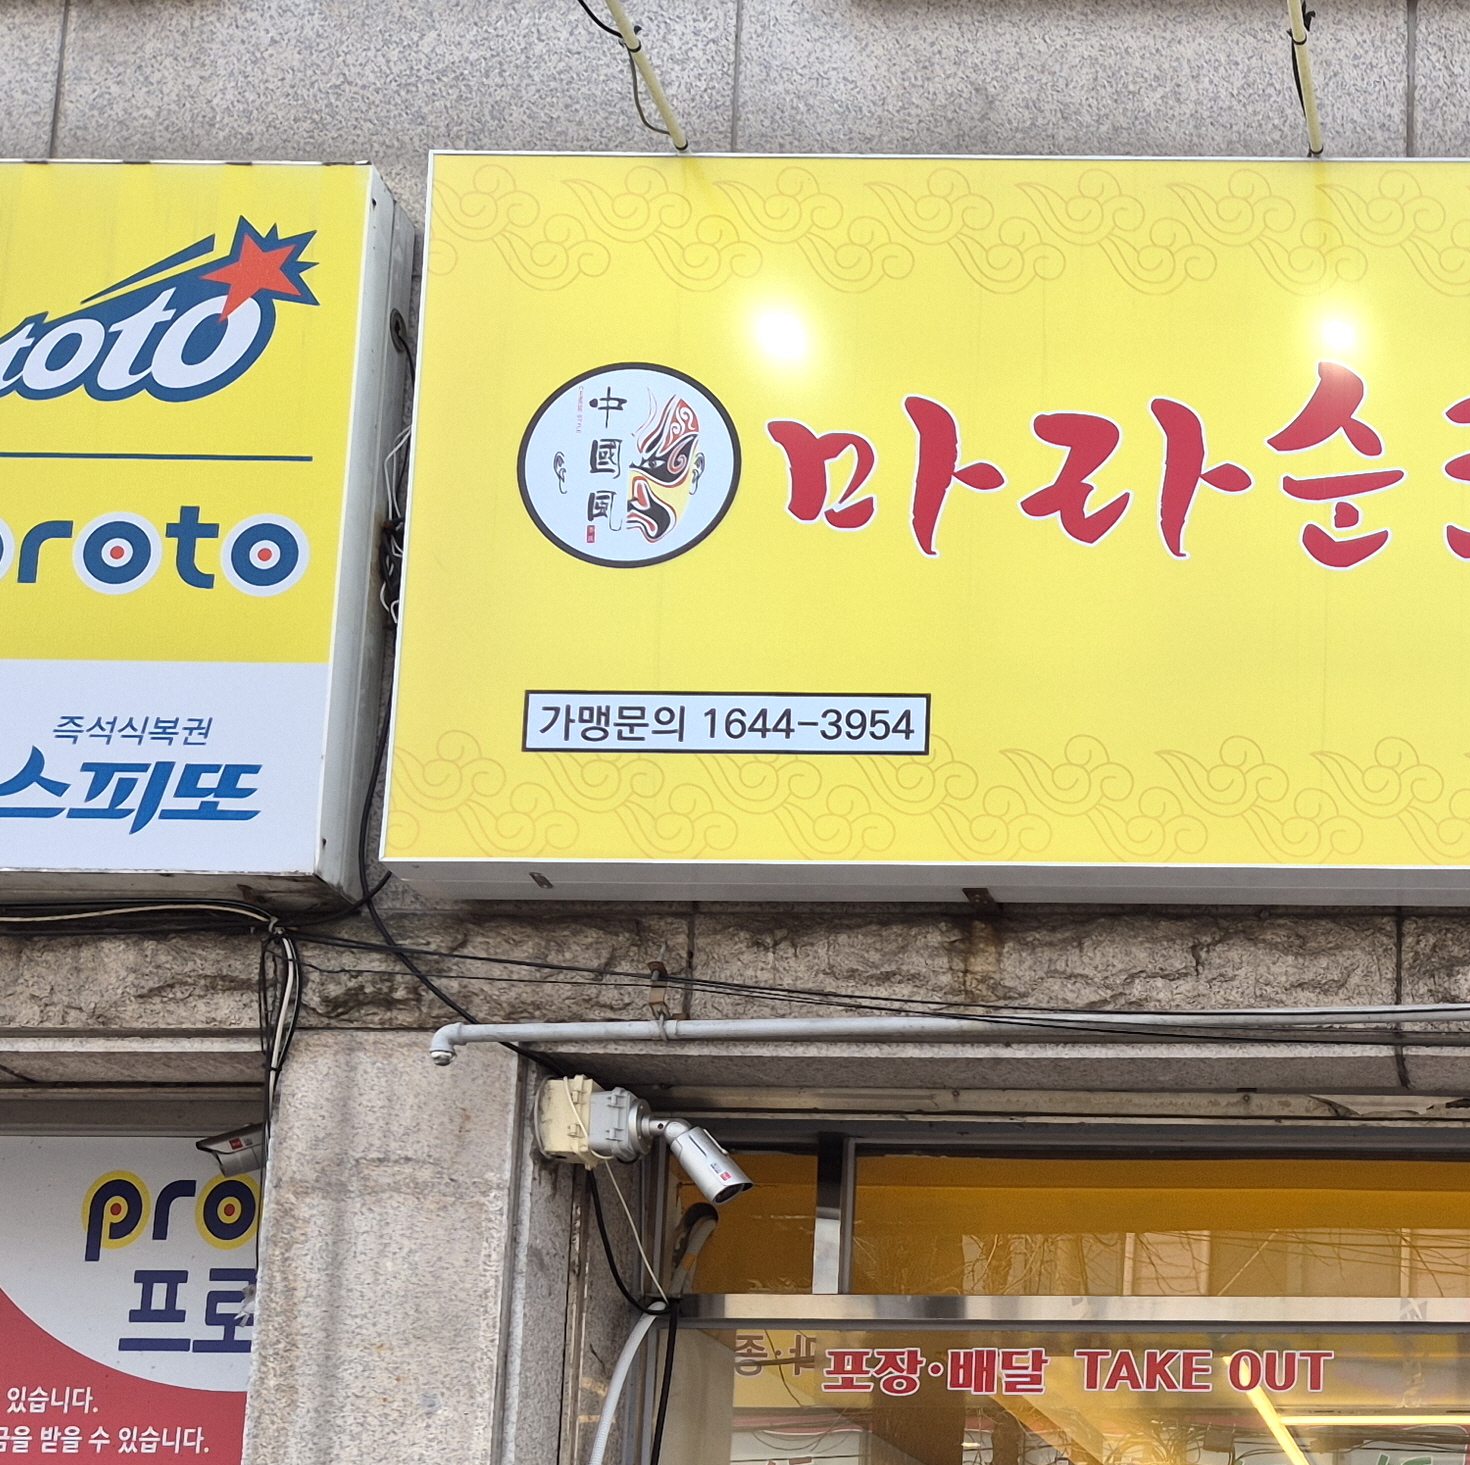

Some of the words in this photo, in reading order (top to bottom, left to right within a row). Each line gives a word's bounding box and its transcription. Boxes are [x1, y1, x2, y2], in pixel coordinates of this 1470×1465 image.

[0, 505, 304, 591] roto
[53, 715, 213, 746] 즉석식복권
[539, 702, 685, 743] 가맹문의
[702, 706, 915, 742] 1644-3954
[0, 745, 263, 835] 스피또
[823, 1348, 1049, 1396] 포장·배달
[1074, 1348, 1213, 1394] TAKE
[1227, 1348, 1335, 1394] OUT
[6, 1385, 99, 1414] 있습니다.
[40, 1425, 83, 1454] 받을
[88, 1425, 111, 1454] 수
[118, 1425, 210, 1454] 있습니다.
